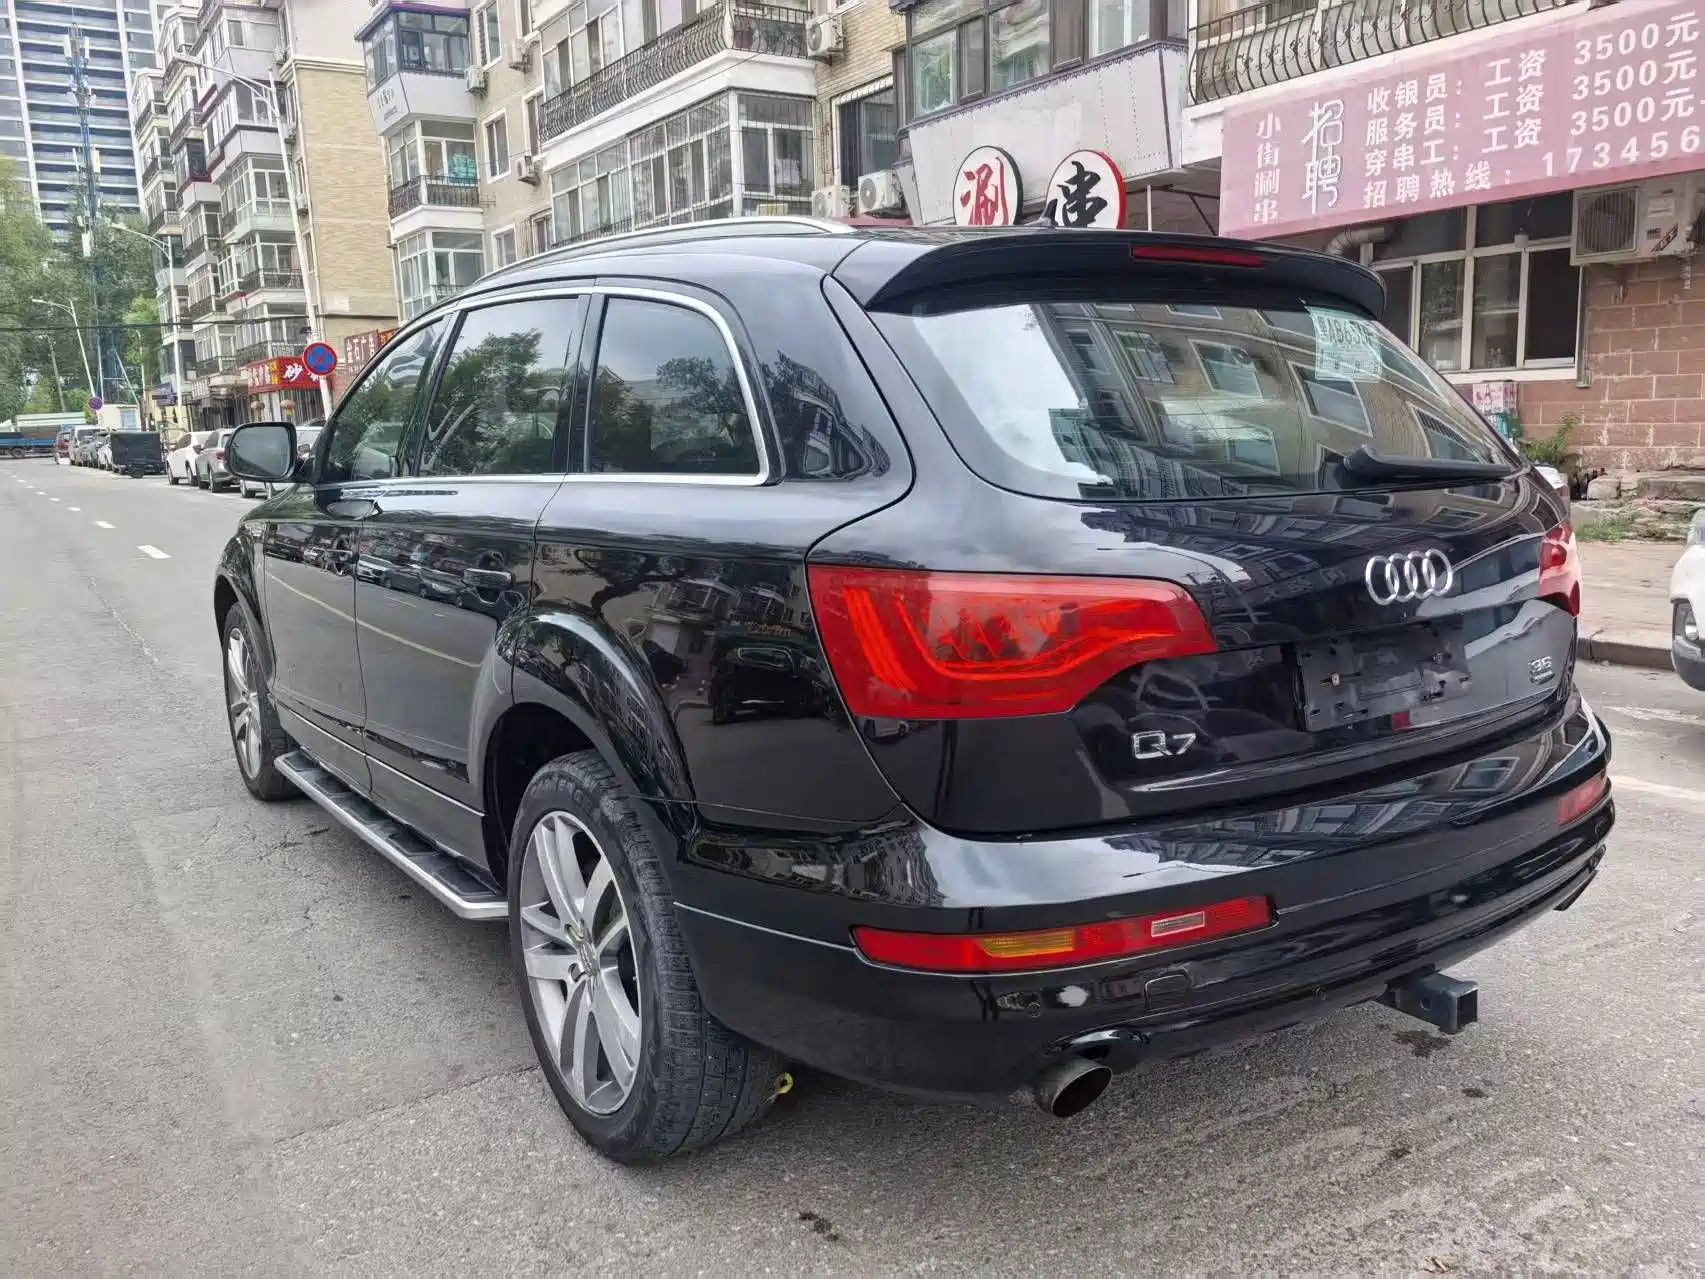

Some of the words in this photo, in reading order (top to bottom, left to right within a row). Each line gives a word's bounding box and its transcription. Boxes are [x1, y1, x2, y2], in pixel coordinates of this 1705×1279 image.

[1484, 48, 1547, 88] 工资
[1574, 10, 1700, 65] 3500元
[1480, 117, 1543, 154] 工资
[1569, 86, 1695, 137] 3500元
[1482, 83, 1545, 121] 工资
[1571, 50, 1698, 101] 3500元
[1300, 98, 1344, 215] 招聘
[1542, 125, 1701, 177] 173456
[1132, 730, 1197, 760] Q7
